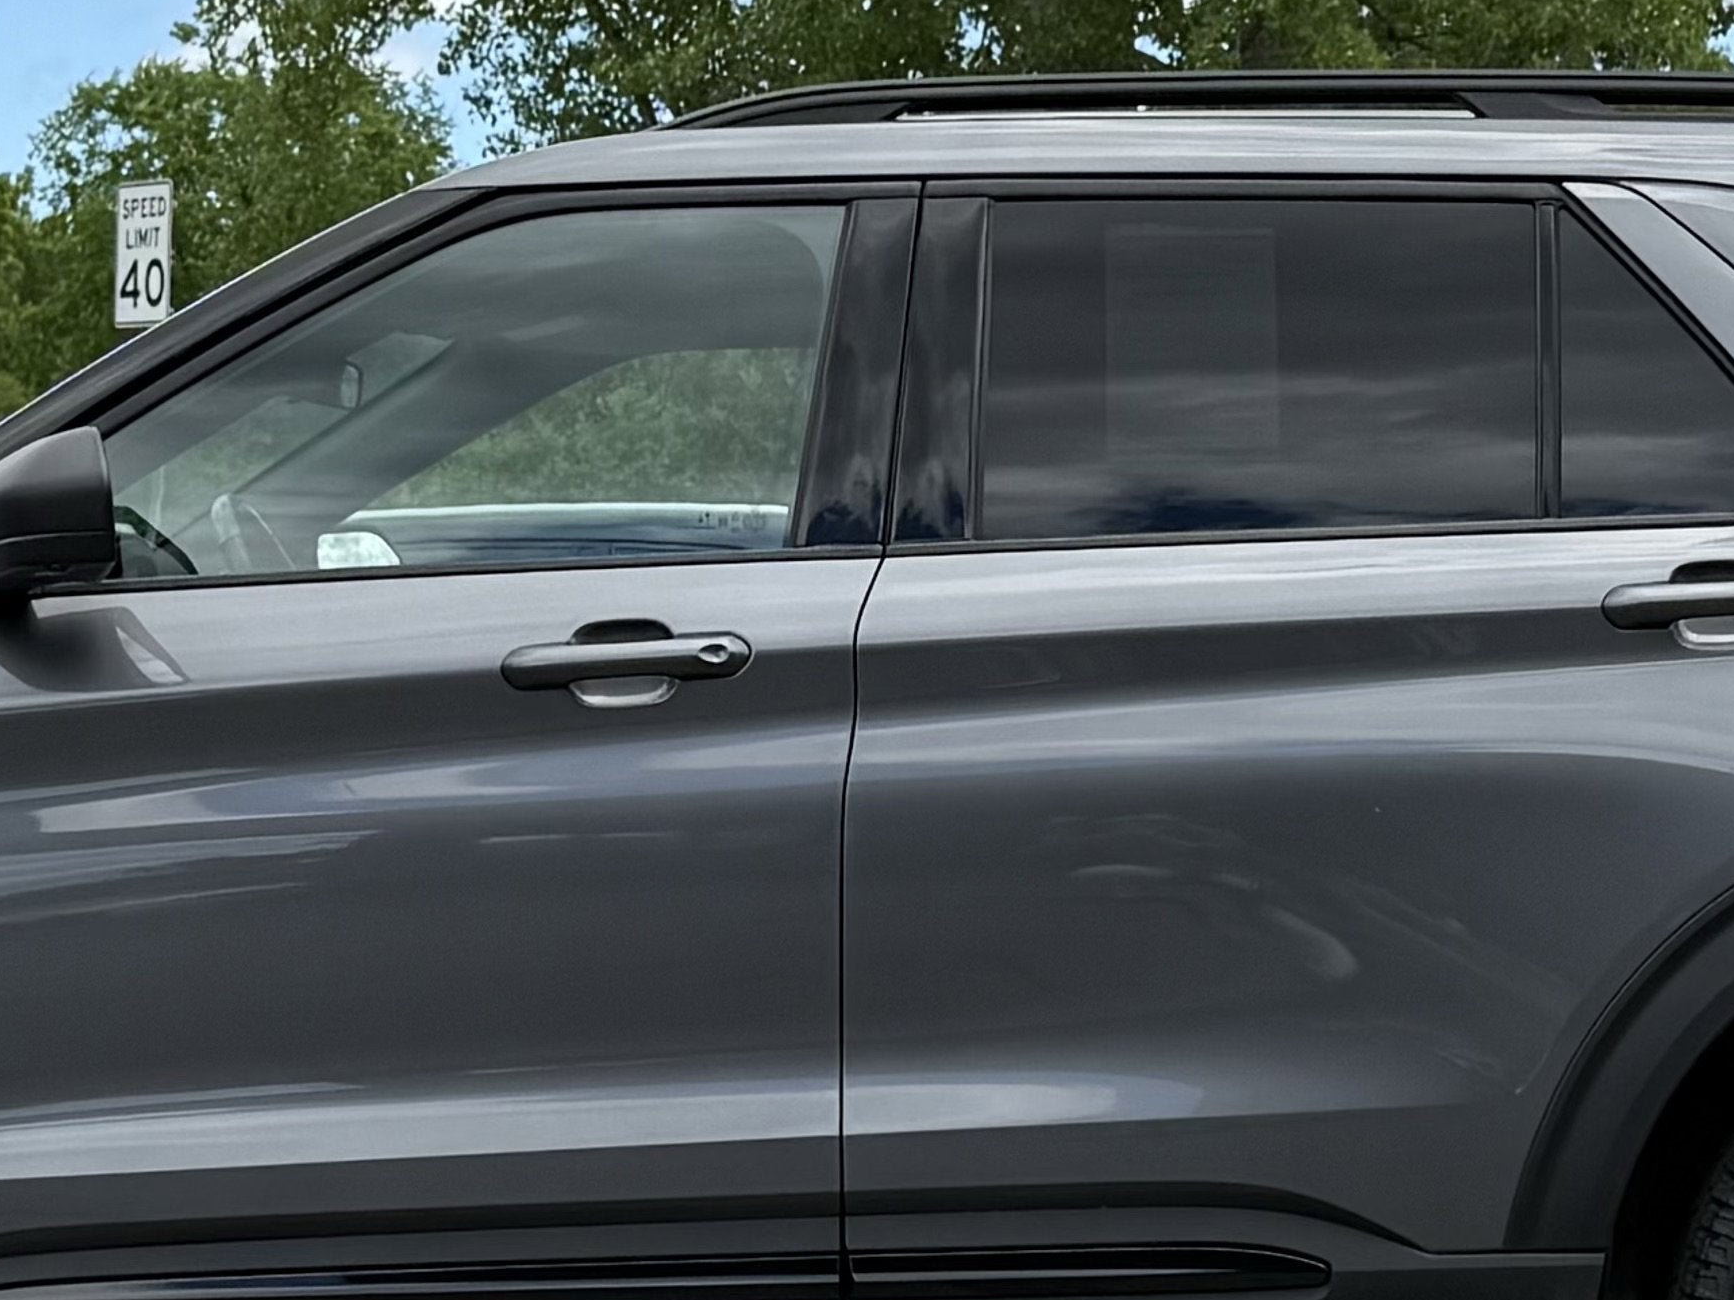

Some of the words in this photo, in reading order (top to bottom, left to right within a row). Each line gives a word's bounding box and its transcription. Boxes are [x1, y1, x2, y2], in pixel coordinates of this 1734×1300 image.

[122, 196, 166, 219] SPEED
[126, 227, 160, 249] LIMIT
[120, 258, 164, 308] 40
